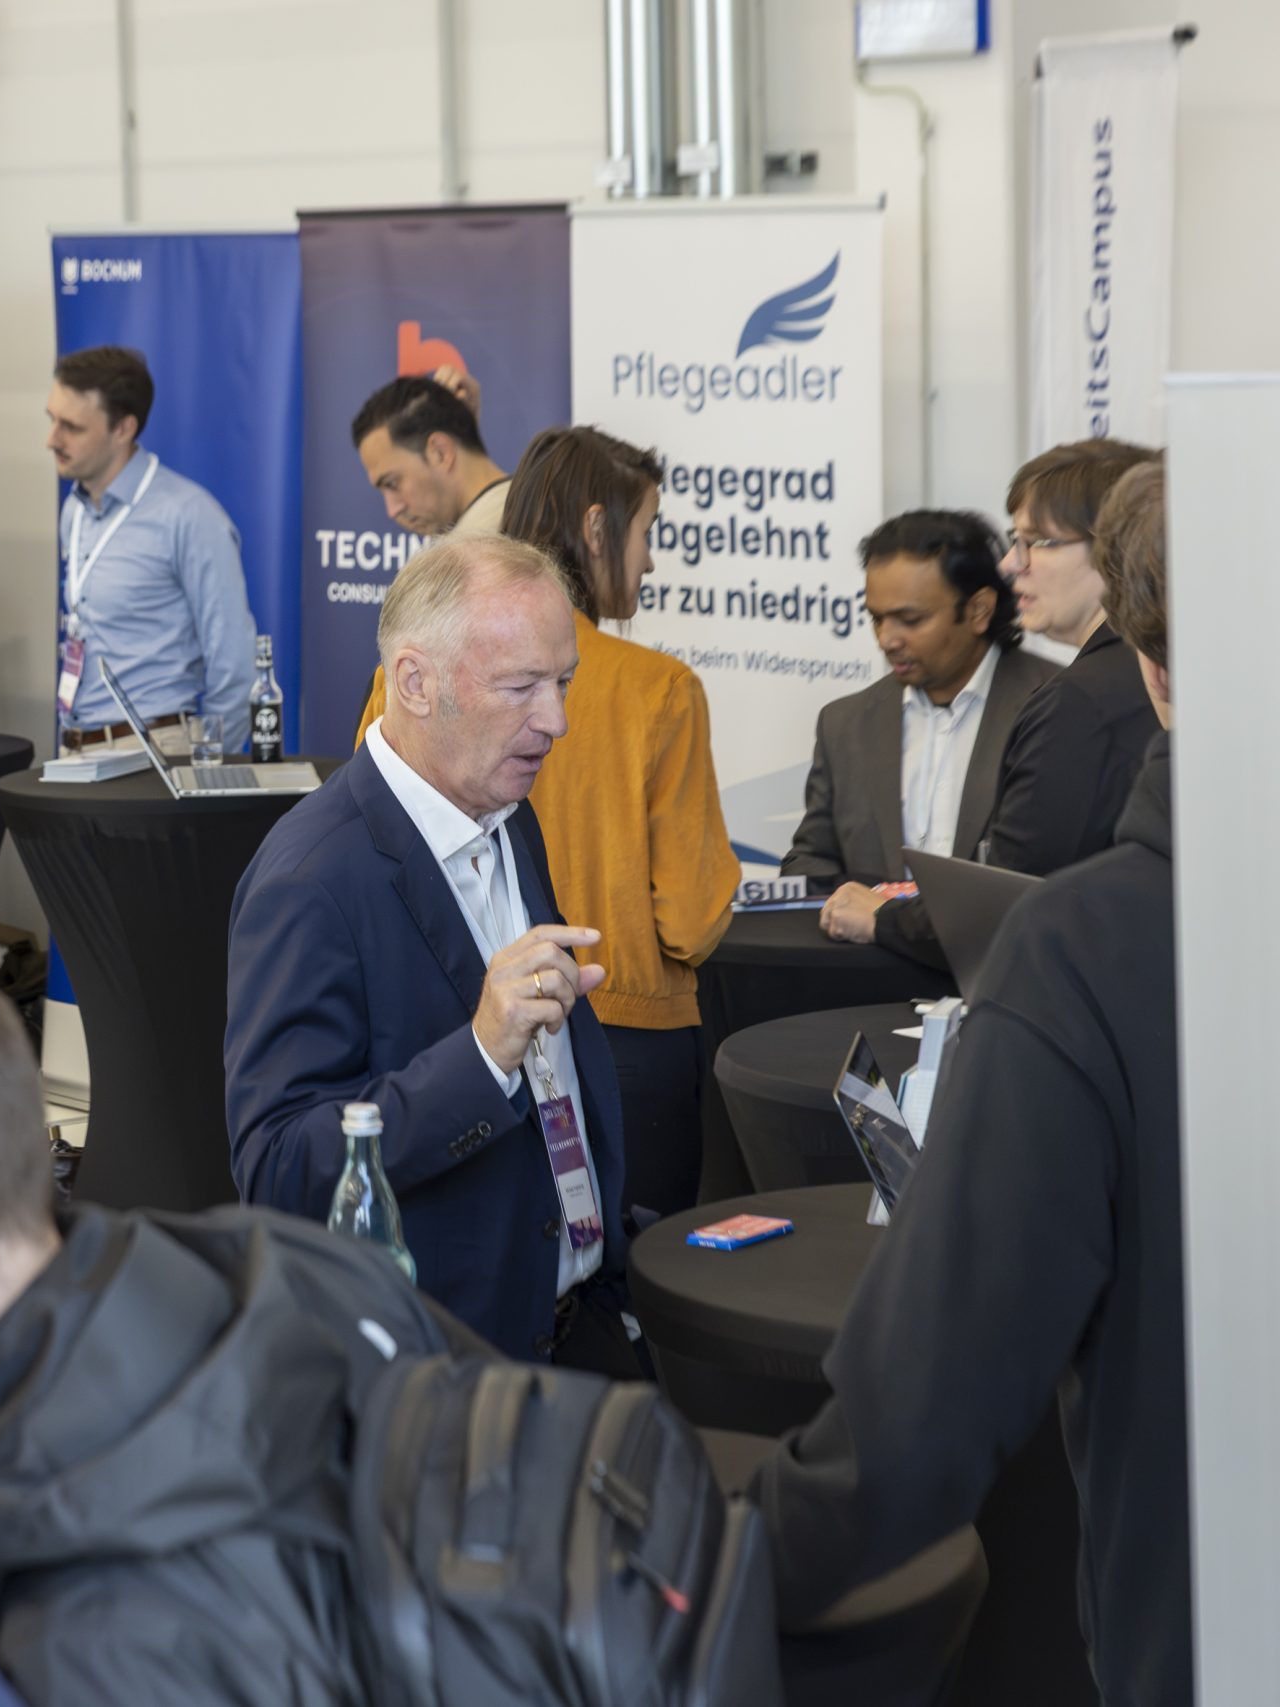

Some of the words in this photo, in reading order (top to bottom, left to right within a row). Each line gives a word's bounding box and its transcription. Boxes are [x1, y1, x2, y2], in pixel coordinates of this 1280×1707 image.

[81, 258, 143, 282] BOCHUM
[1083, 117, 1117, 439] eitsCampus
[611, 351, 843, 414] Pflegeadler
[660, 454, 835, 513] legegrad
[315, 529, 433, 572] TECHN
[647, 513, 831, 567] bgelehnt
[638, 582, 671, 611] er
[678, 584, 715, 616] zu
[726, 577, 868, 638] niedrig?
[689, 643, 739, 671] beim
[742, 648, 872, 684] Widerspruch!
